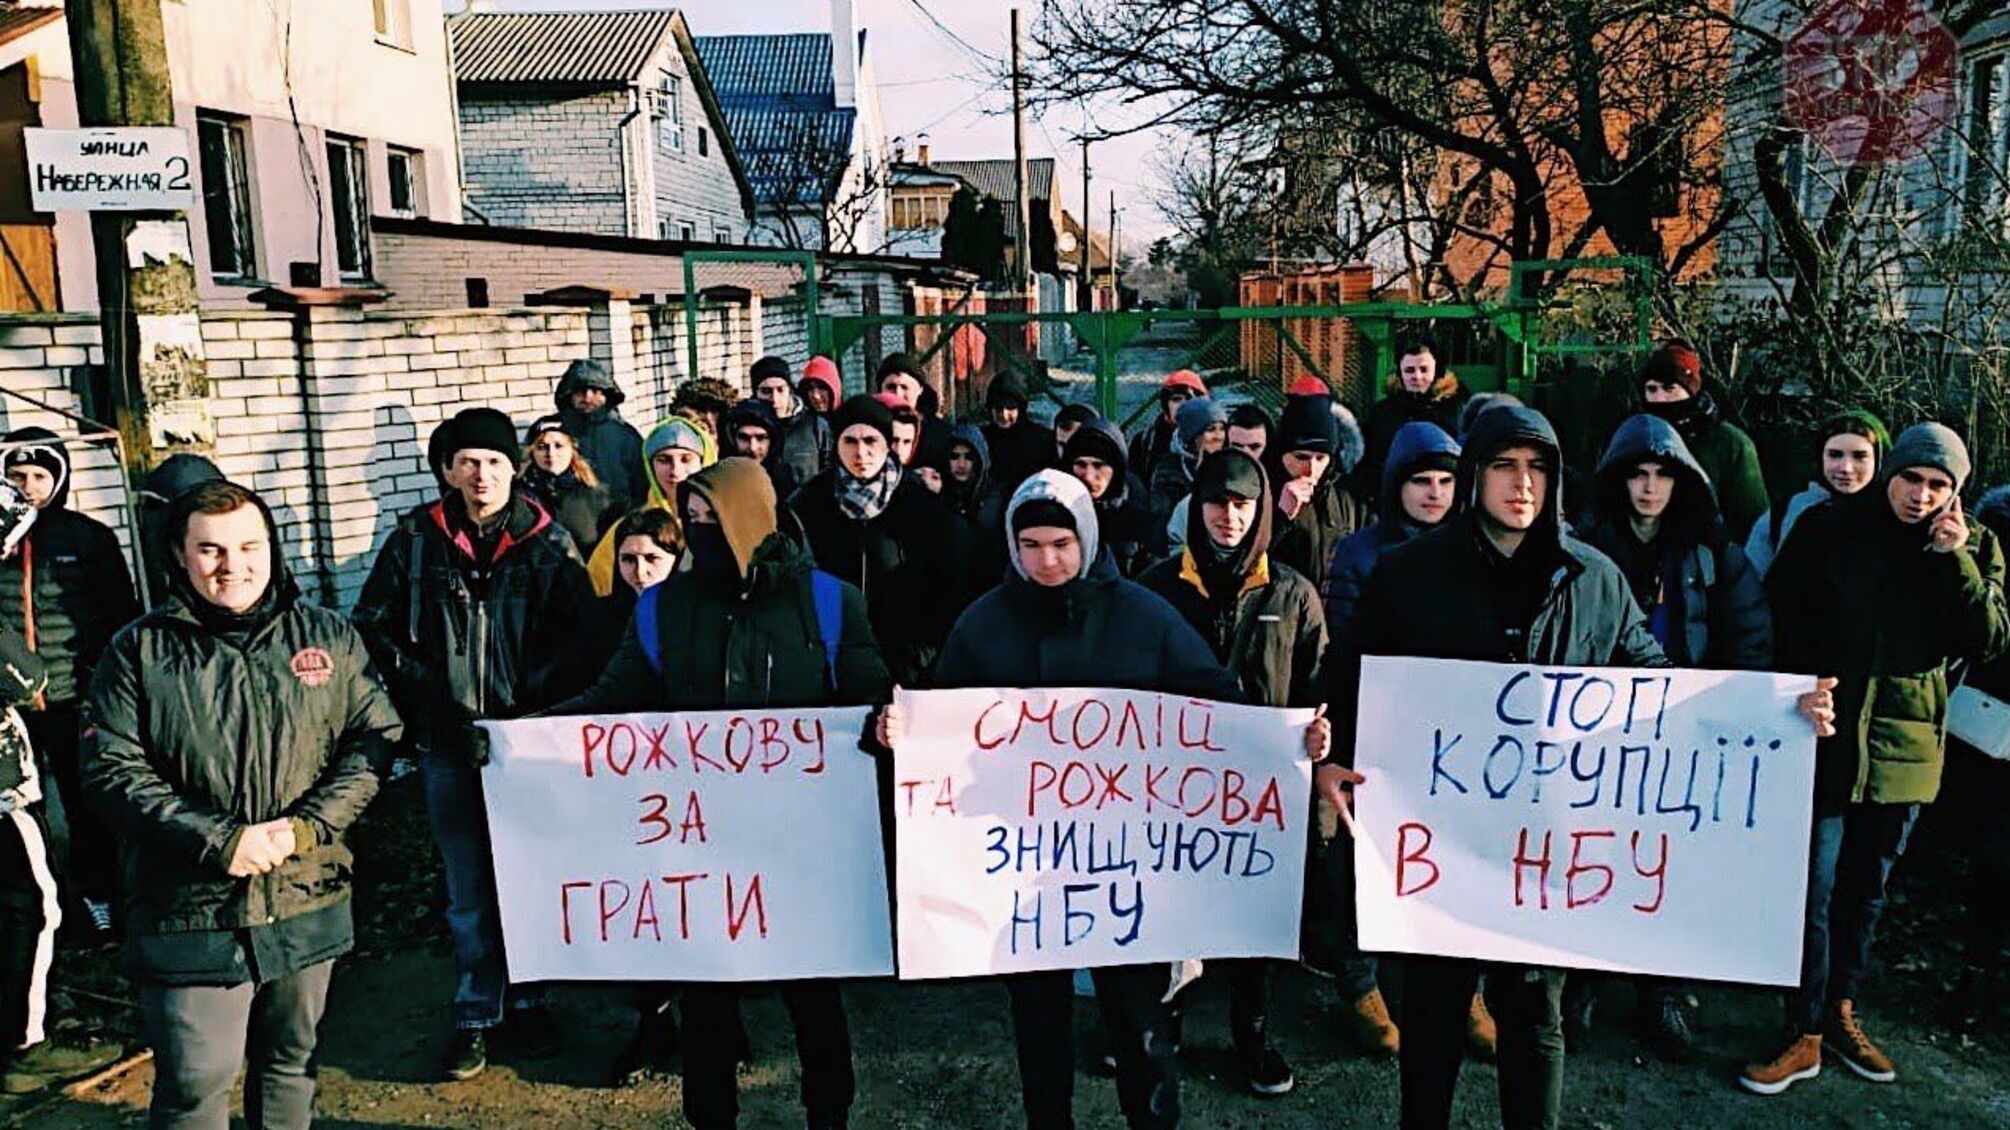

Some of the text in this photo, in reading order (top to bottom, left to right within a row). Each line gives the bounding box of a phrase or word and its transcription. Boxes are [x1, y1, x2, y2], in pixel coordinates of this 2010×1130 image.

[80, 141, 150, 157] УЛИЦА
[165, 156, 192, 190] 2
[974, 695, 1226, 752] СМОЛІЙ
[1495, 671, 1672, 740] СТОП
[581, 717, 827, 778] РОЖКОВУ
[1429, 728, 1782, 831] КОРУПЦІЇ
[635, 790, 707, 844] ЗА
[900, 761, 1286, 831] ТА РОЖКОВА
[985, 821, 1276, 878] ЗНИЩУЮТЬ
[1395, 822, 1669, 913] В НБУ
[561, 872, 768, 944] ГРАТИ
[1010, 881, 1145, 955] НБУ
